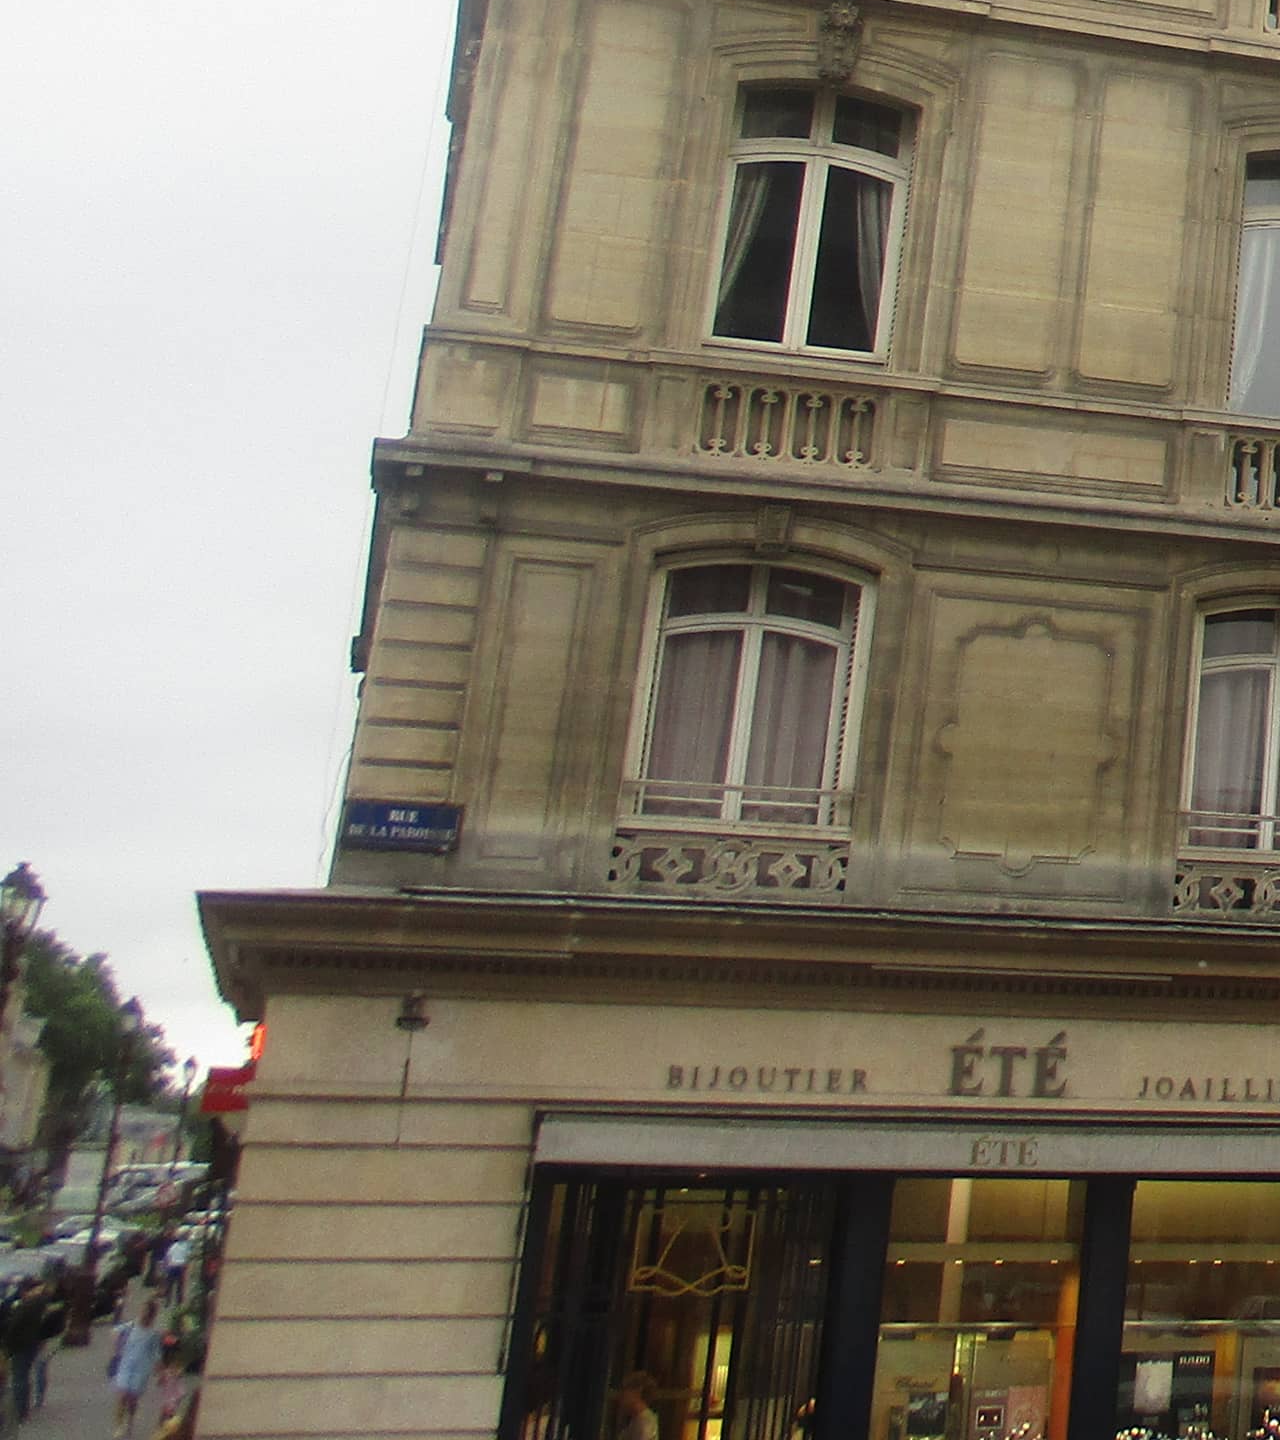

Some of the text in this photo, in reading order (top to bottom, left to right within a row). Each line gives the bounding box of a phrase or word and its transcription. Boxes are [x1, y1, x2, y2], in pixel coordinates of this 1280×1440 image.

[388, 809, 419, 823] RUE
[370, 826, 388, 837] LA
[667, 1064, 867, 1092] BIJOUTIER
[949, 1027, 1068, 1098] ÉTÉ
[970, 1135, 1039, 1166] ÉTÉ
